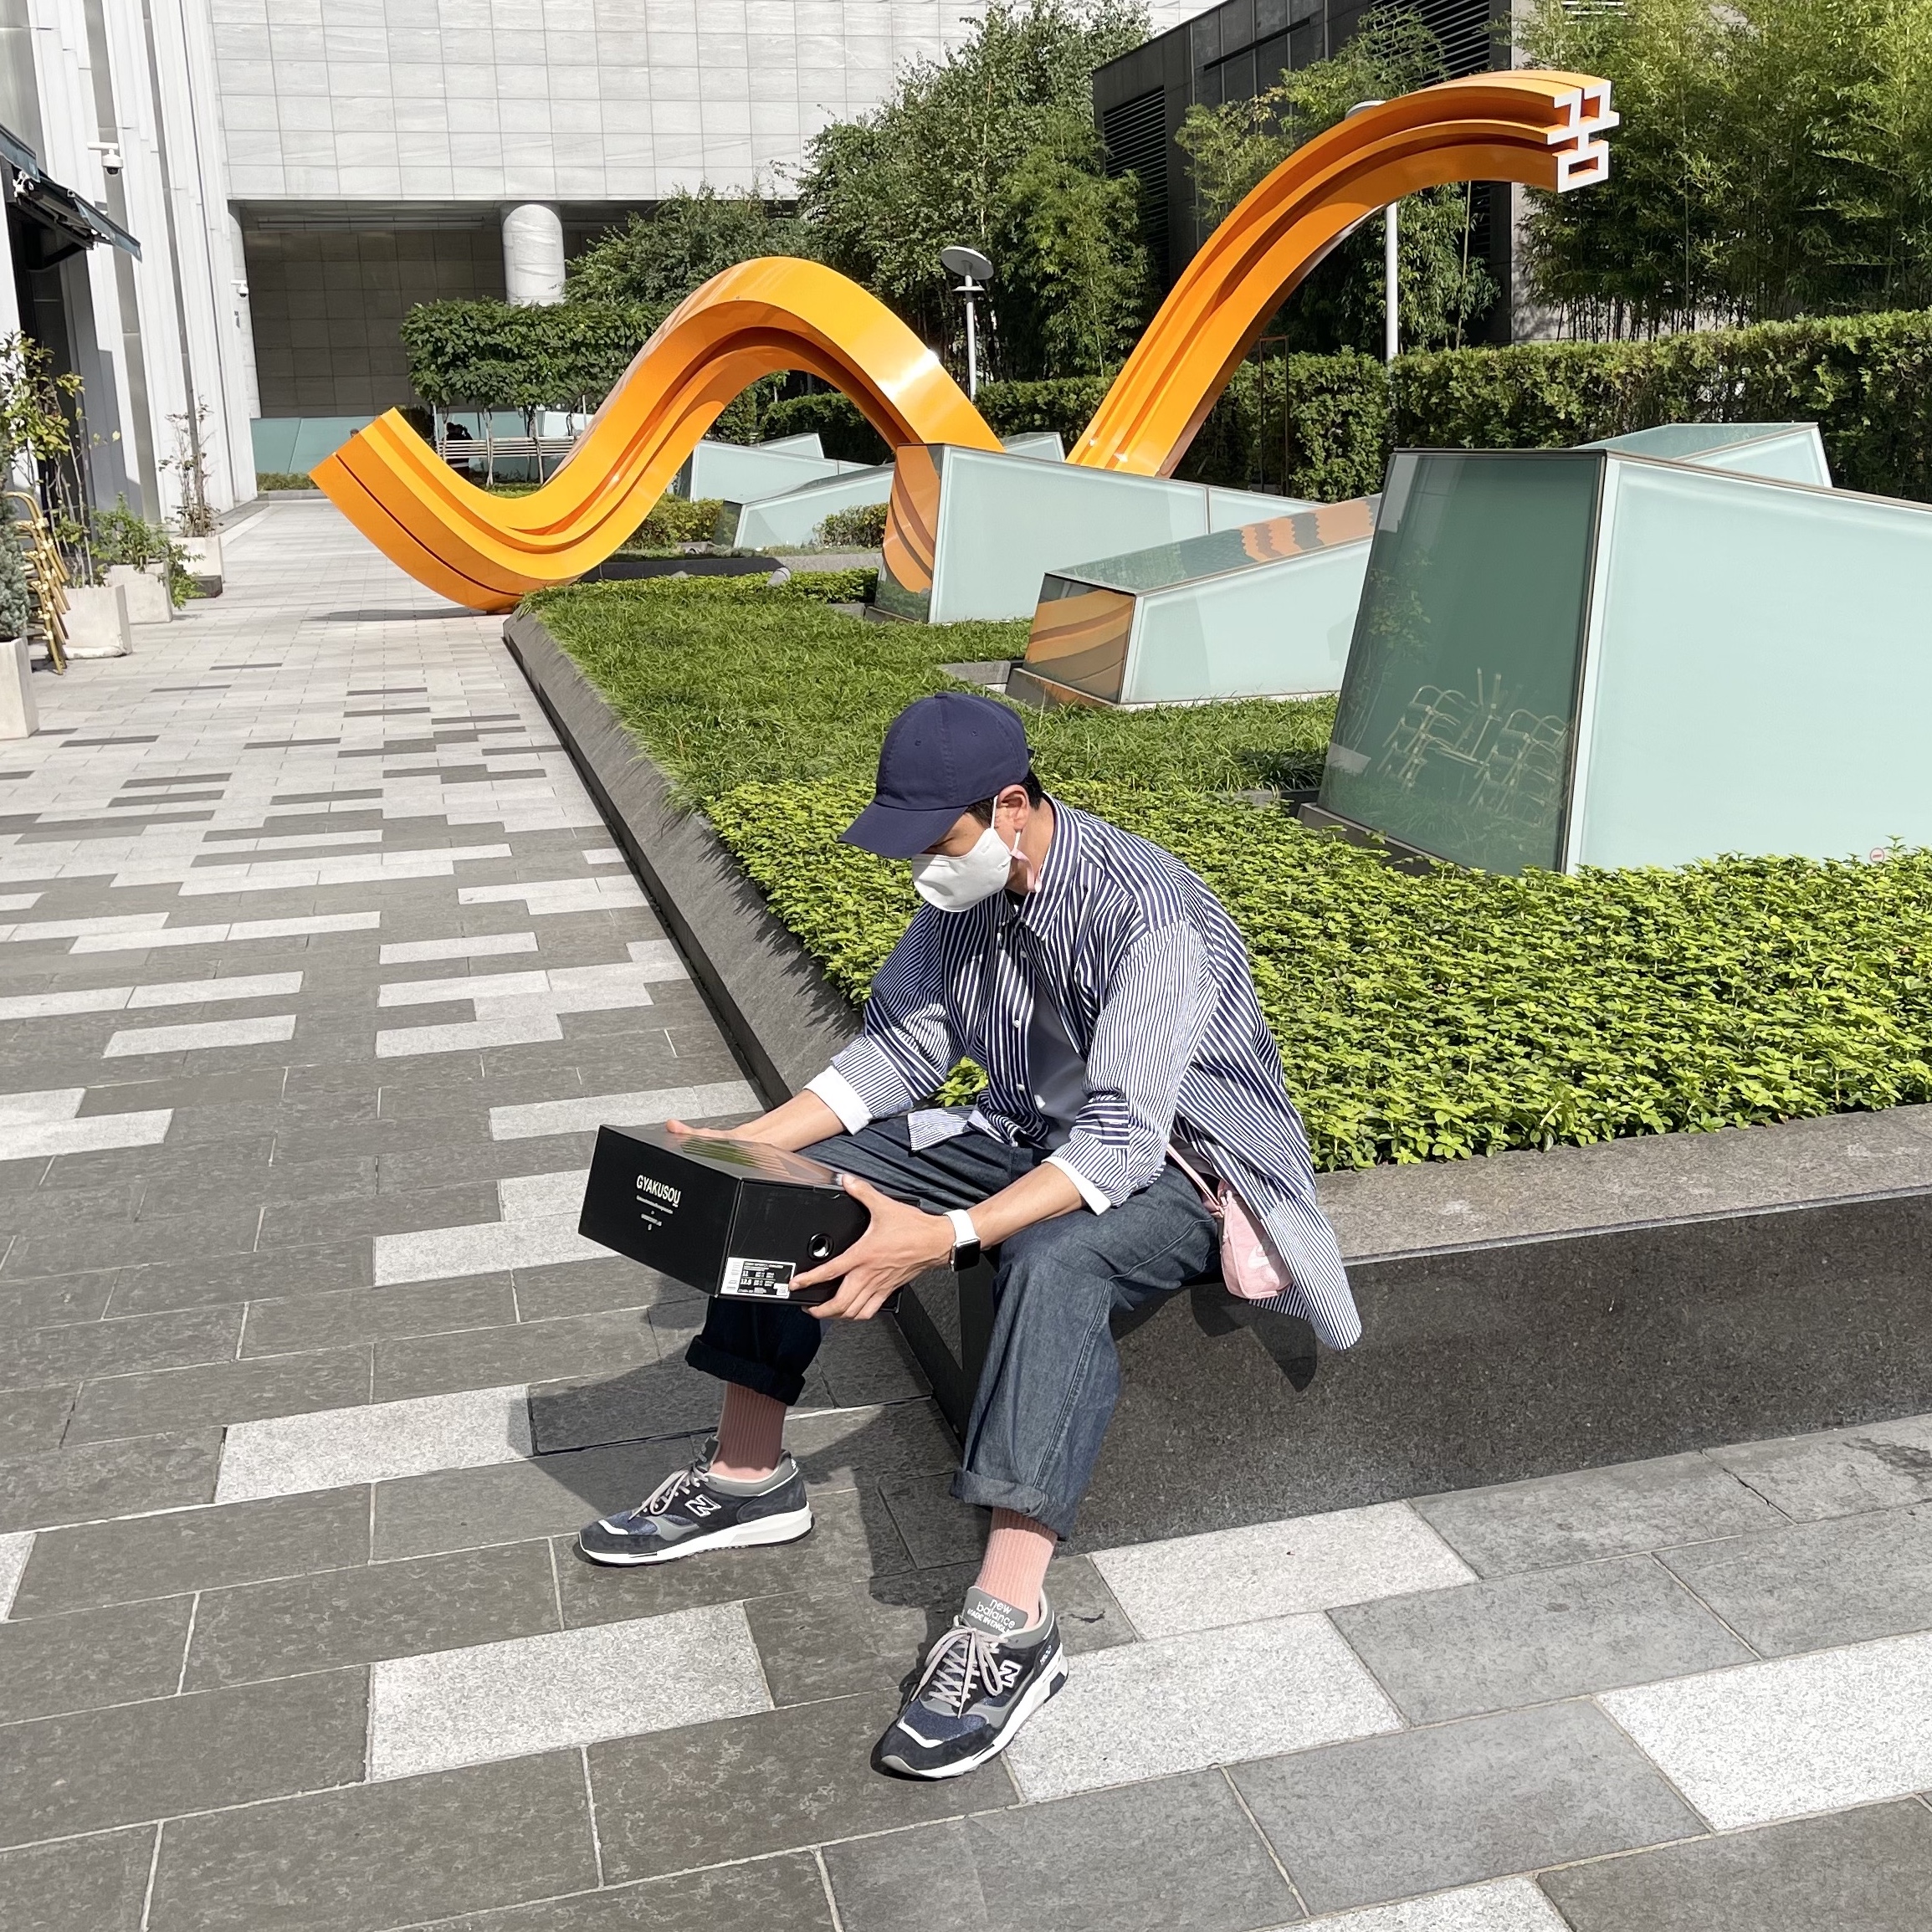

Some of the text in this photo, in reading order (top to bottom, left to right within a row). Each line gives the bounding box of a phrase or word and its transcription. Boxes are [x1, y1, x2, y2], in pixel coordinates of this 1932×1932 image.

[636, 1174, 681, 1207] GYAKUSOU
[967, 1608, 985, 1622] MADE
[982, 1616, 992, 1626] IN
[976, 1601, 1016, 1629] balance
[989, 1599, 1012, 1614] new
